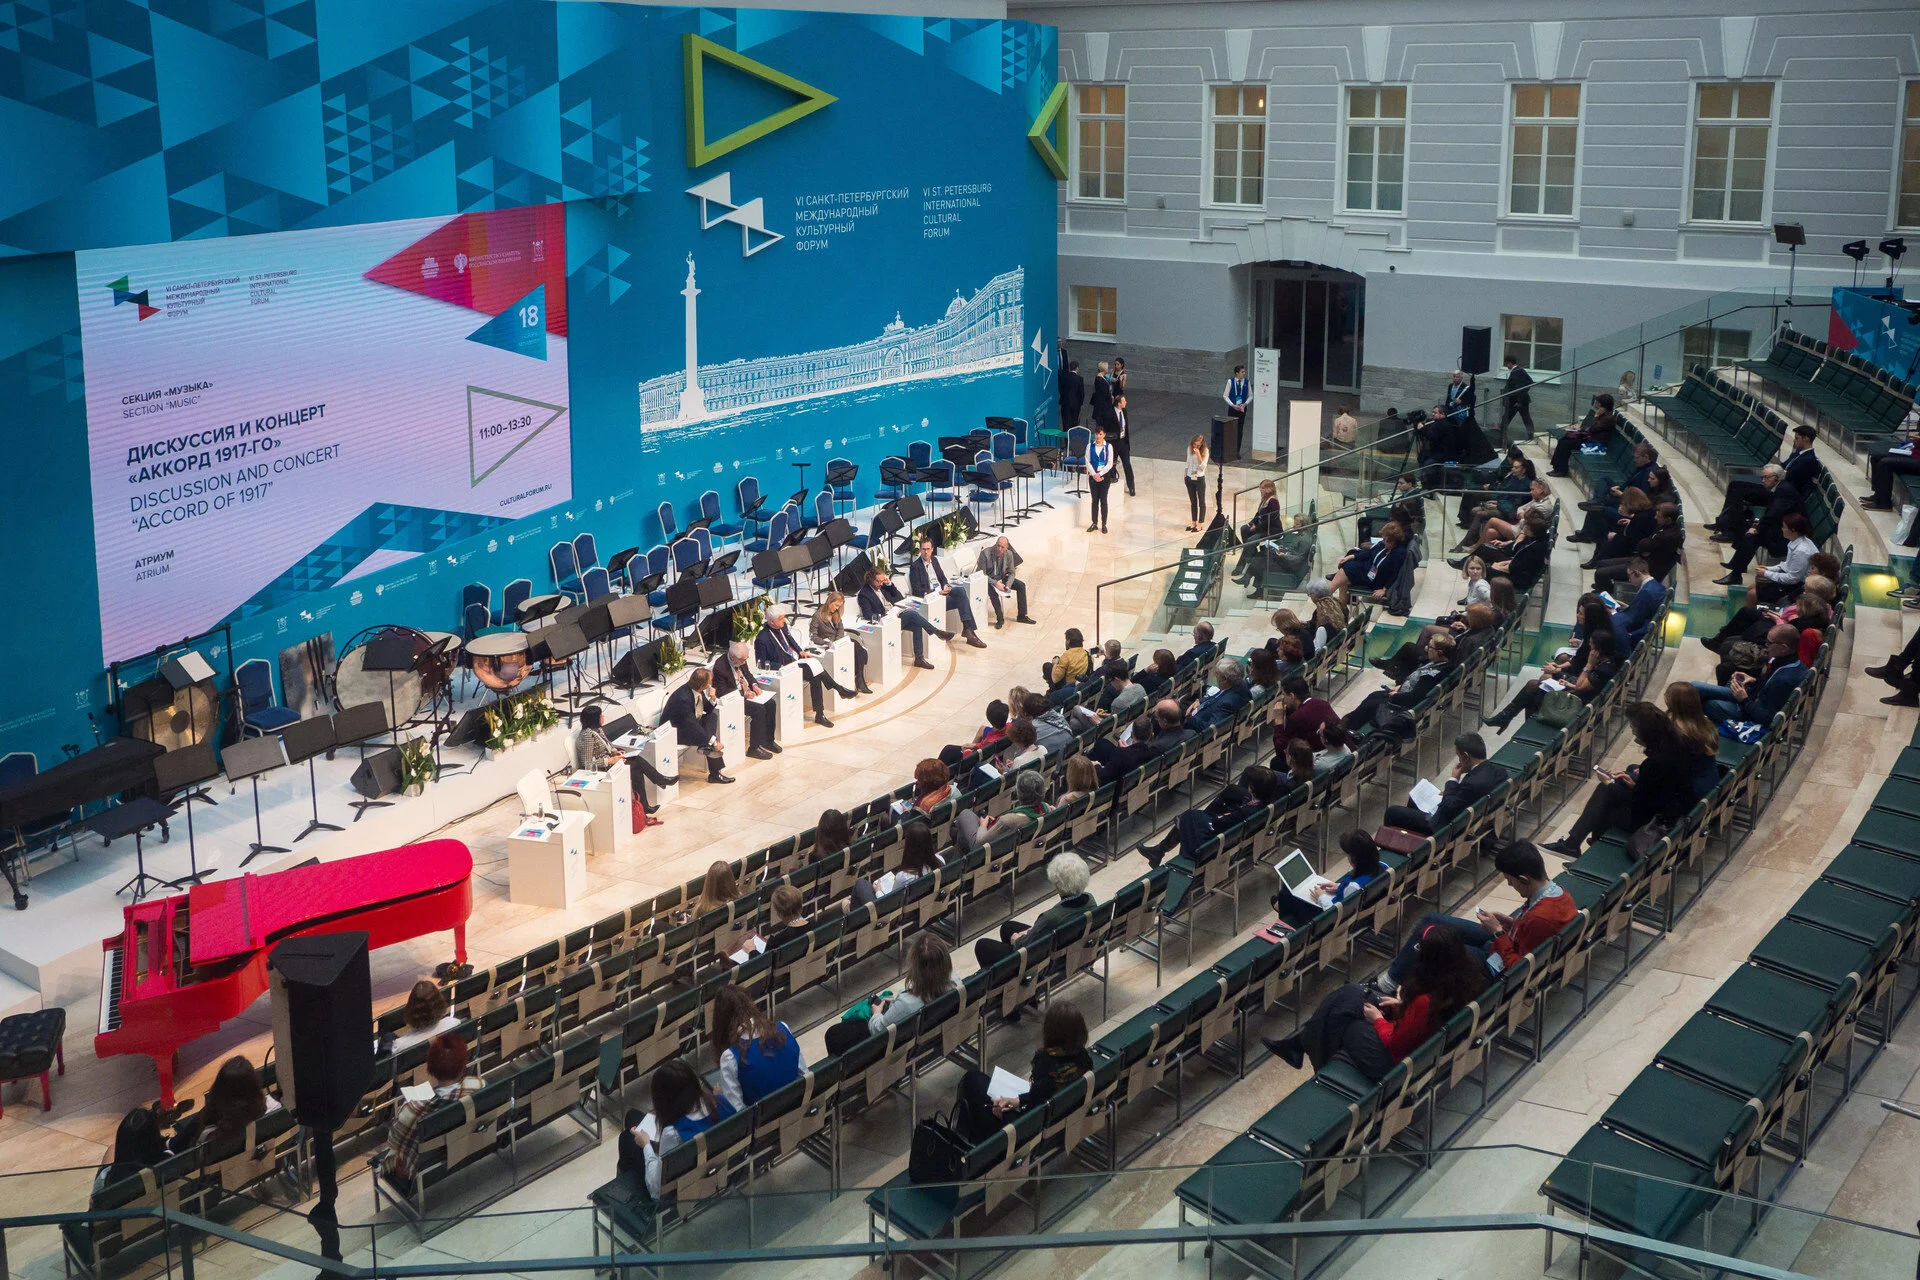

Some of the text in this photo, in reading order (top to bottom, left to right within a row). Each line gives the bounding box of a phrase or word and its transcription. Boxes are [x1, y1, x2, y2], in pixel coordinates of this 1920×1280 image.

[795, 187, 909, 207] VI САНКТ-ПЕТЕРБУРГСКИЙ
[923, 183, 992, 197] VI ST. PETERSBURG
[795, 203, 879, 222] МЕЖДУНАРОДНЫЙ
[923, 199, 981, 211] INTERNATIONAL
[795, 219, 856, 237] КУЛЬТУРНЫЙ
[923, 212, 962, 225] CULTURAL
[923, 227, 950, 239] FORUM
[795, 239, 829, 251] ФОРУМ
[167, 309, 189, 318] ФОРУМ
[518, 304, 539, 328] 18
[121, 381, 214, 406] СЕКЦИЯ «МУЗЫКА»
[122, 403, 164, 419] SECTION
[127, 404, 326, 466] ДИСКУССИЯ И КОНЦЕРТ
[128, 437, 282, 485] «АККОРД 1917-ГО»
[130, 443, 340, 512] DISCUSSION AND CONCERT
[213, 491, 236, 510] OF
[499, 483, 552, 507] CULTURALFORUM.RU
[134, 549, 175, 570] АТРИУМ
[135, 564, 170, 583] ATRIUM
